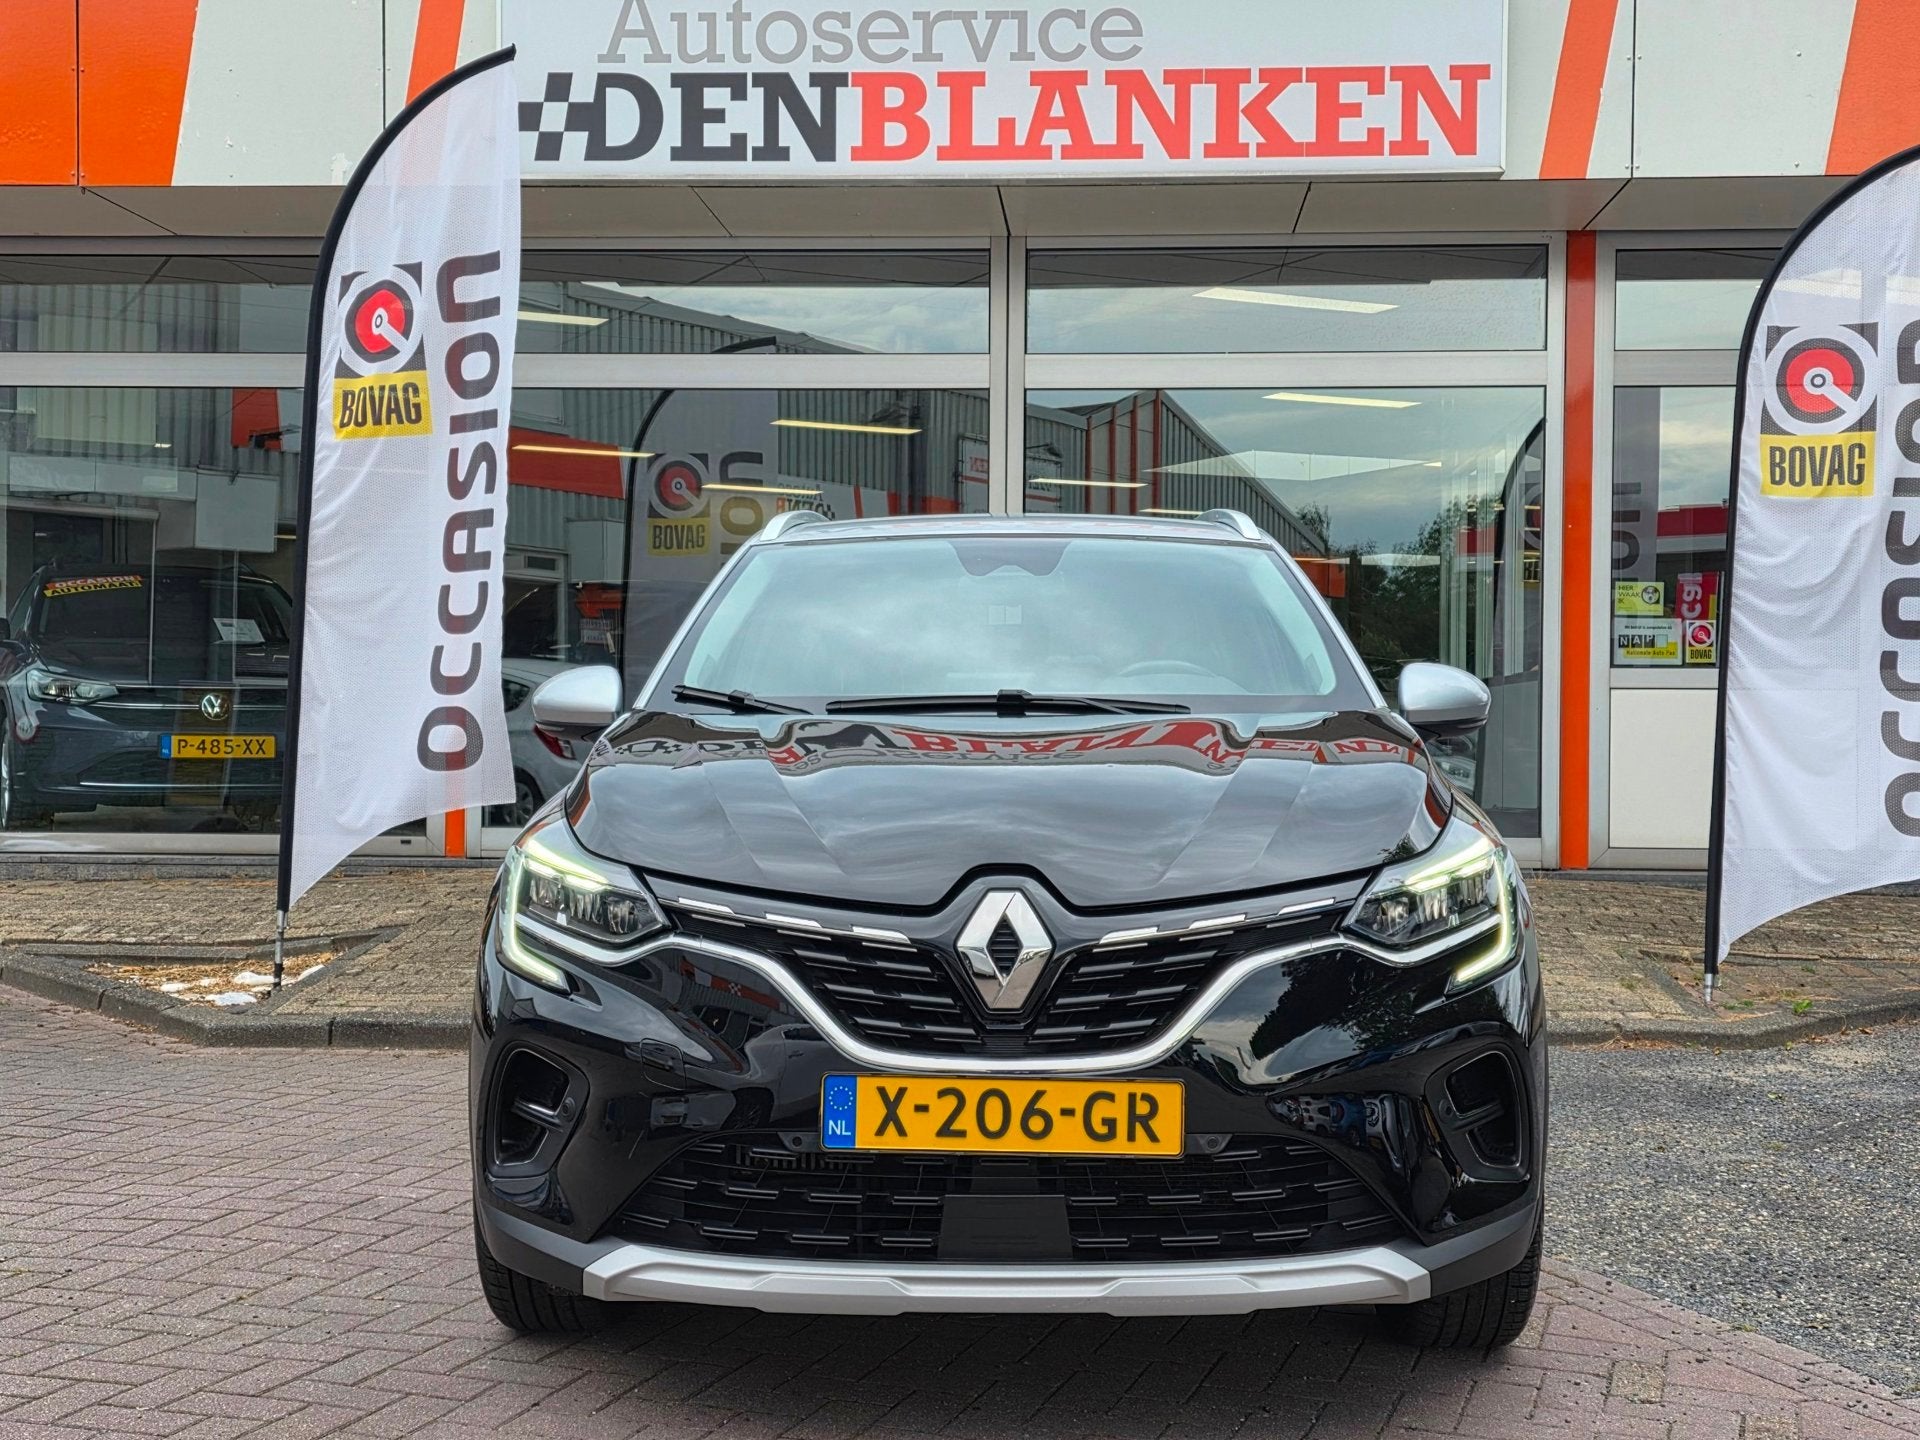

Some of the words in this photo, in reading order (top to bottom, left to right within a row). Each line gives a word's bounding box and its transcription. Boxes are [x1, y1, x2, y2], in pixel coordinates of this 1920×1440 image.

[597, 0, 1144, 64] Autoservice
[339, 381, 423, 429] BOVAG
[1768, 442, 1867, 488] BOVAG
[416, 250, 501, 772] OCCASION
[652, 524, 706, 551] BOVAG
[54, 575, 136, 588] OCCASION
[1619, 635, 1655, 648] NAP
[1690, 649, 1712, 660] BOVAG
[177, 738, 267, 755] P-485-XX
[828, 1119, 852, 1137] NL
[874, 1085, 1162, 1144] X-206-GR
